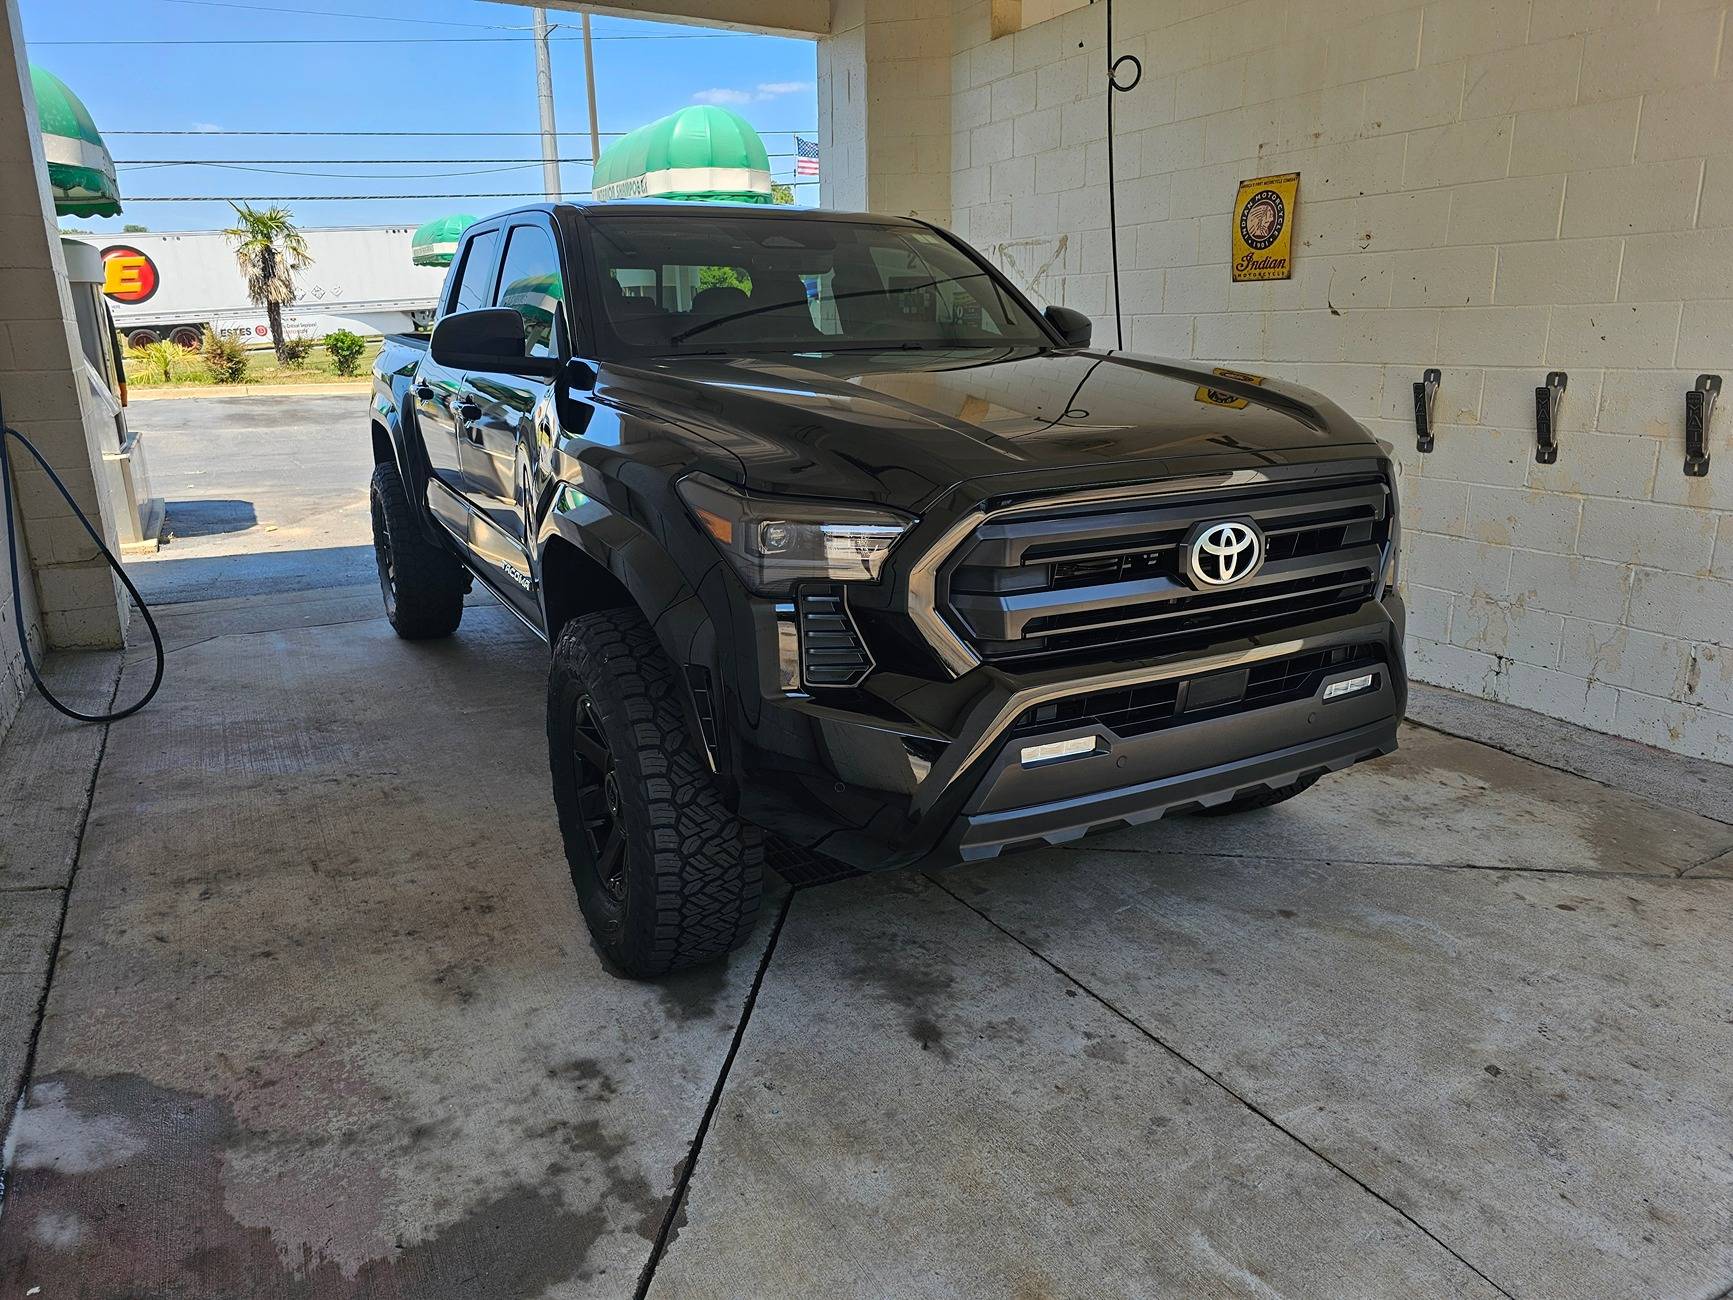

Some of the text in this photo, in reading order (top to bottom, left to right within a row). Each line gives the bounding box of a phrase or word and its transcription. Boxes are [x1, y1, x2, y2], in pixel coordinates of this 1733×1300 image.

[1241, 192, 1284, 239] INDIAN MOTORCYCLE
[102, 256, 146, 295] E
[1235, 252, 1287, 272] Indian
[220, 327, 252, 337] ESTES
[501, 560, 532, 591] TACOMA
